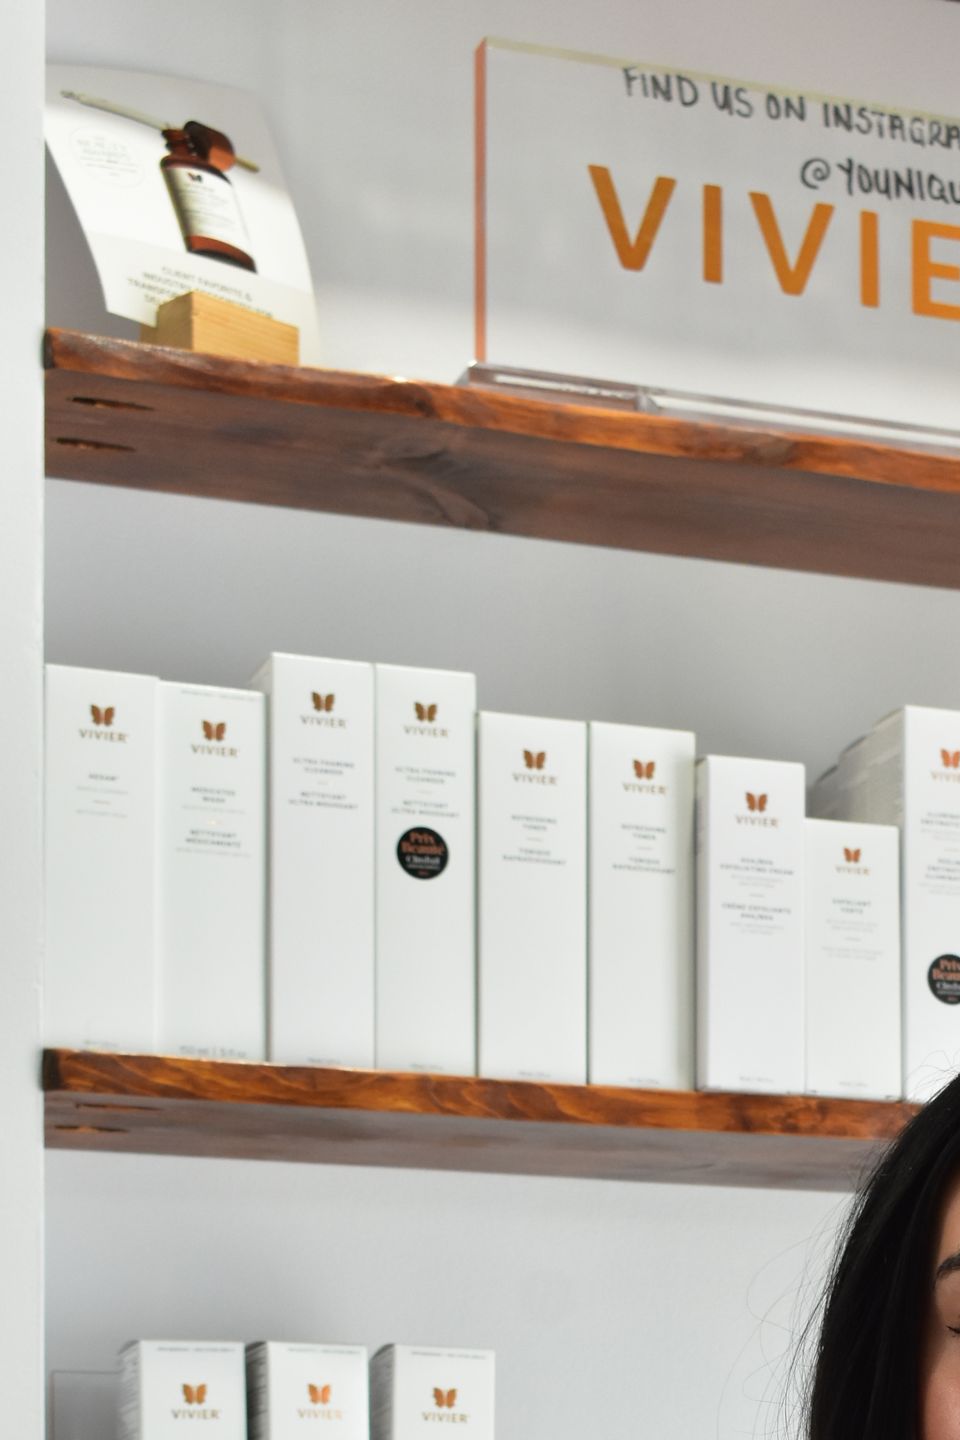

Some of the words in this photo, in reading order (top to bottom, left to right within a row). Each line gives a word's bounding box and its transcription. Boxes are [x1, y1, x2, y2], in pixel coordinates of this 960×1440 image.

[622, 66, 698, 107] FIND
[710, 81, 753, 118] US
[766, 94, 806, 122] ON
[300, 714, 347, 729] VIVIER
[79, 728, 127, 743] VIVIER
[403, 725, 449, 738] VIVIER
[191, 744, 239, 758] VIVIER
[512, 772, 557, 786] VIVIER
[622, 782, 667, 795] VIVIER
[735, 815, 779, 828] VIVIER
[171, 1409, 220, 1420] VIVIER
[297, 1408, 343, 1420] VIVIER
[421, 1411, 468, 1423] VIVIER
